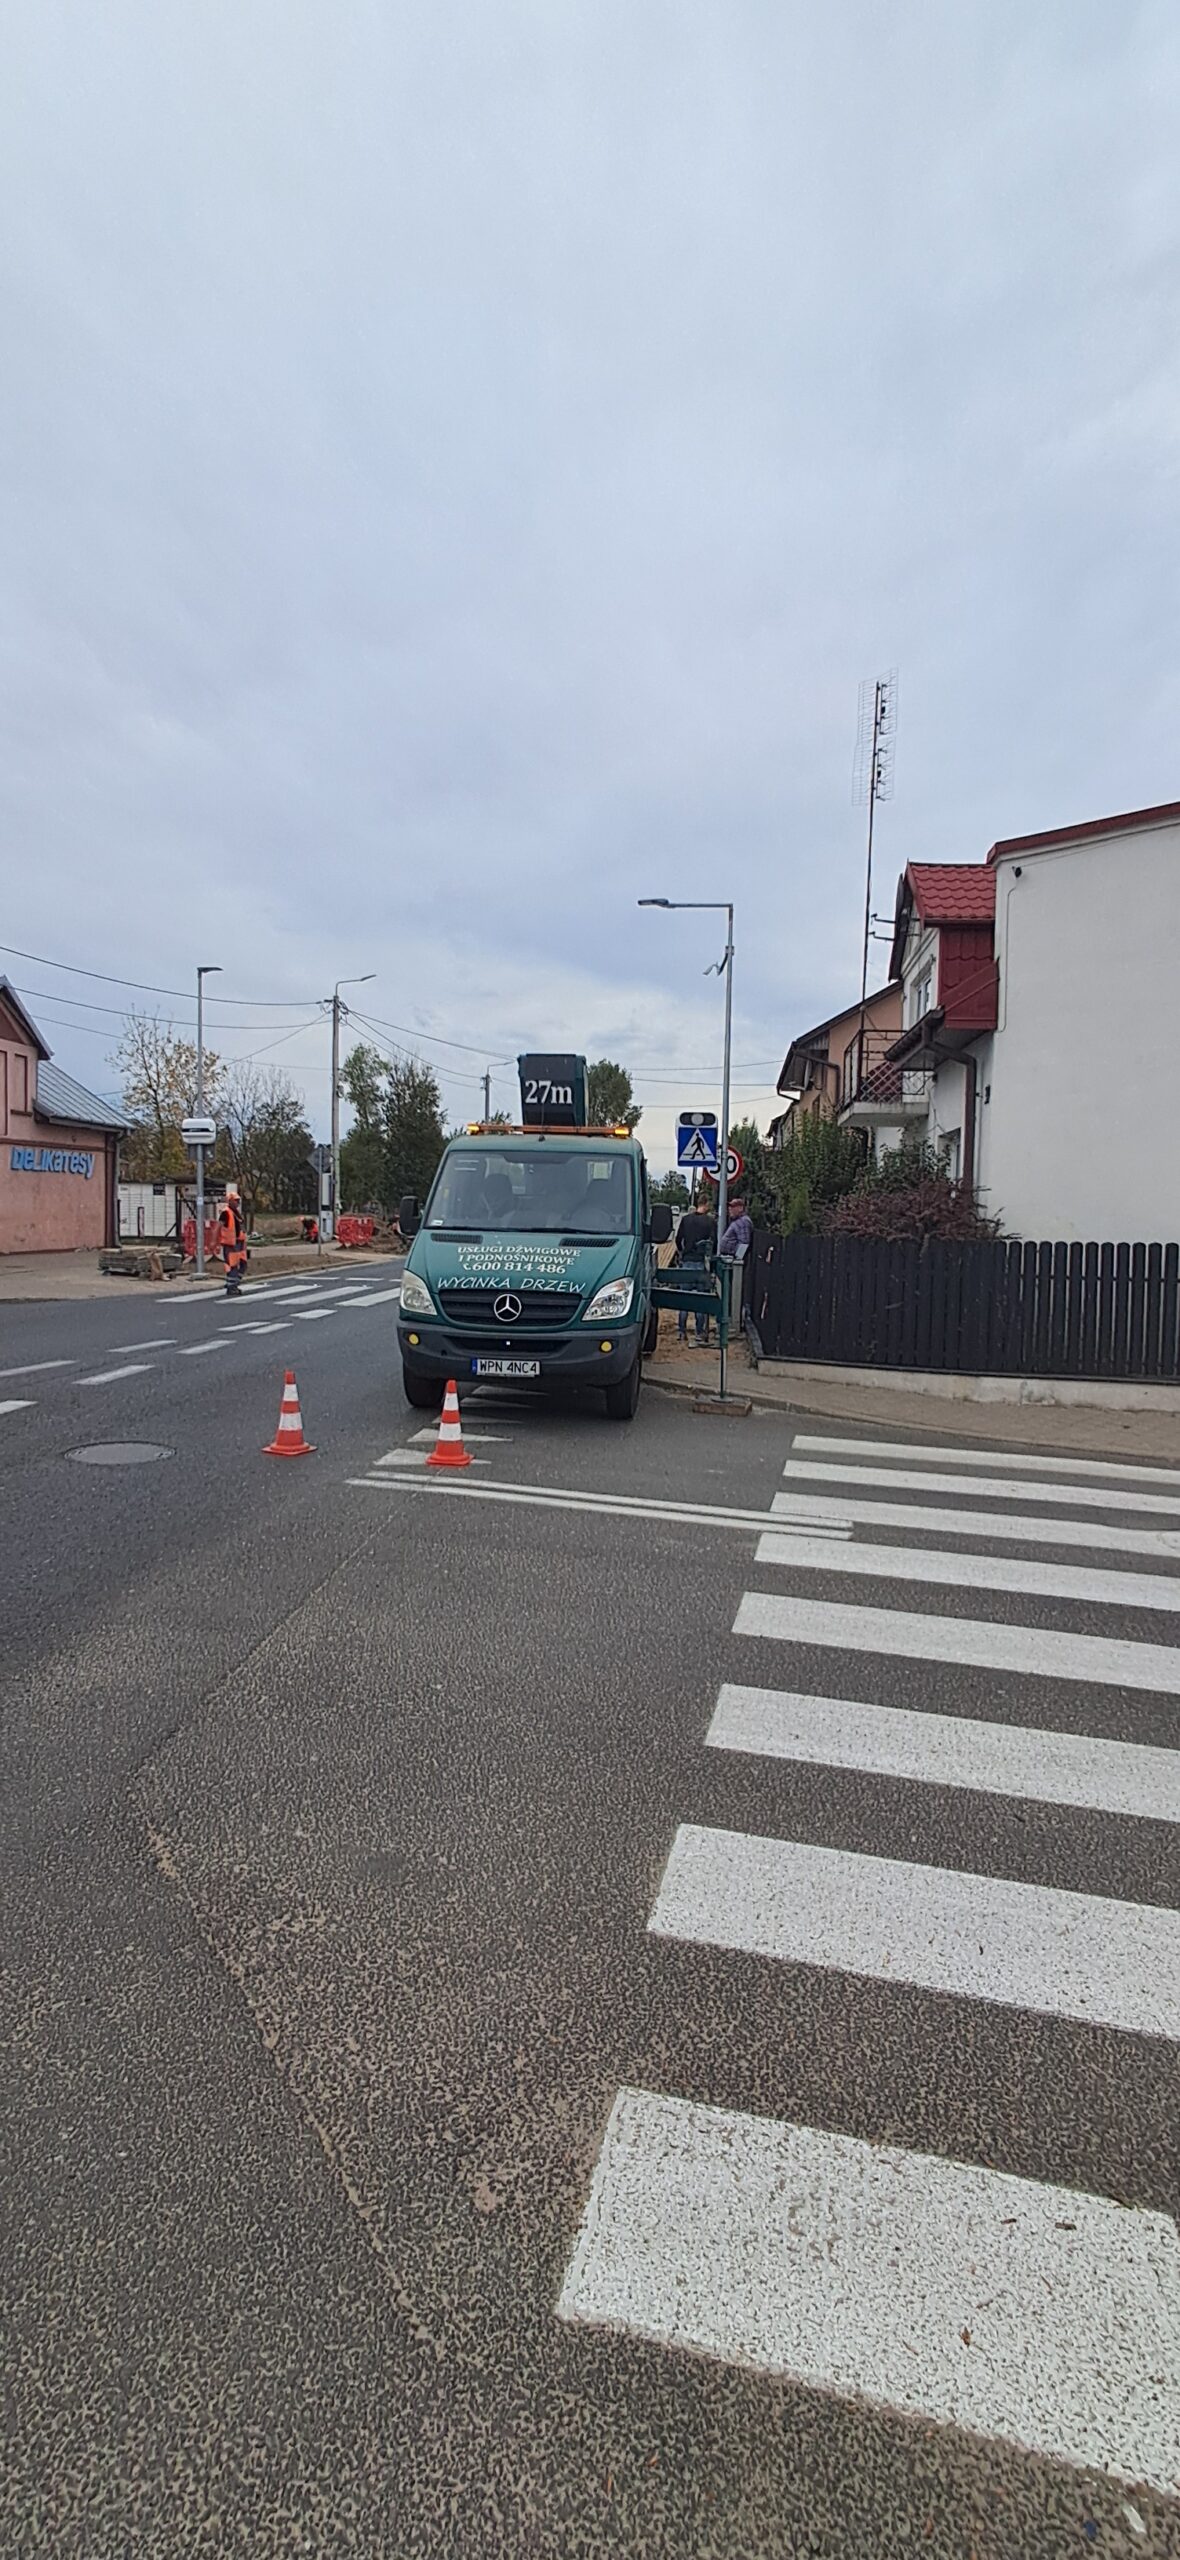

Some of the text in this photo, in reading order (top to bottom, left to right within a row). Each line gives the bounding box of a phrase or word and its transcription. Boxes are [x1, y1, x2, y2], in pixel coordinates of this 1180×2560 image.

[525, 1080, 572, 1104] 27m
[457, 1244, 582, 1257] USŁUGI DŹWIGOWE
[466, 1253, 575, 1265] PODNOŚNIKOWE
[472, 1261, 566, 1274] 600 814 486
[437, 1276, 586, 1292] WYCINKA DRZEW
[480, 1361, 537, 1374] WPN 4NC4
